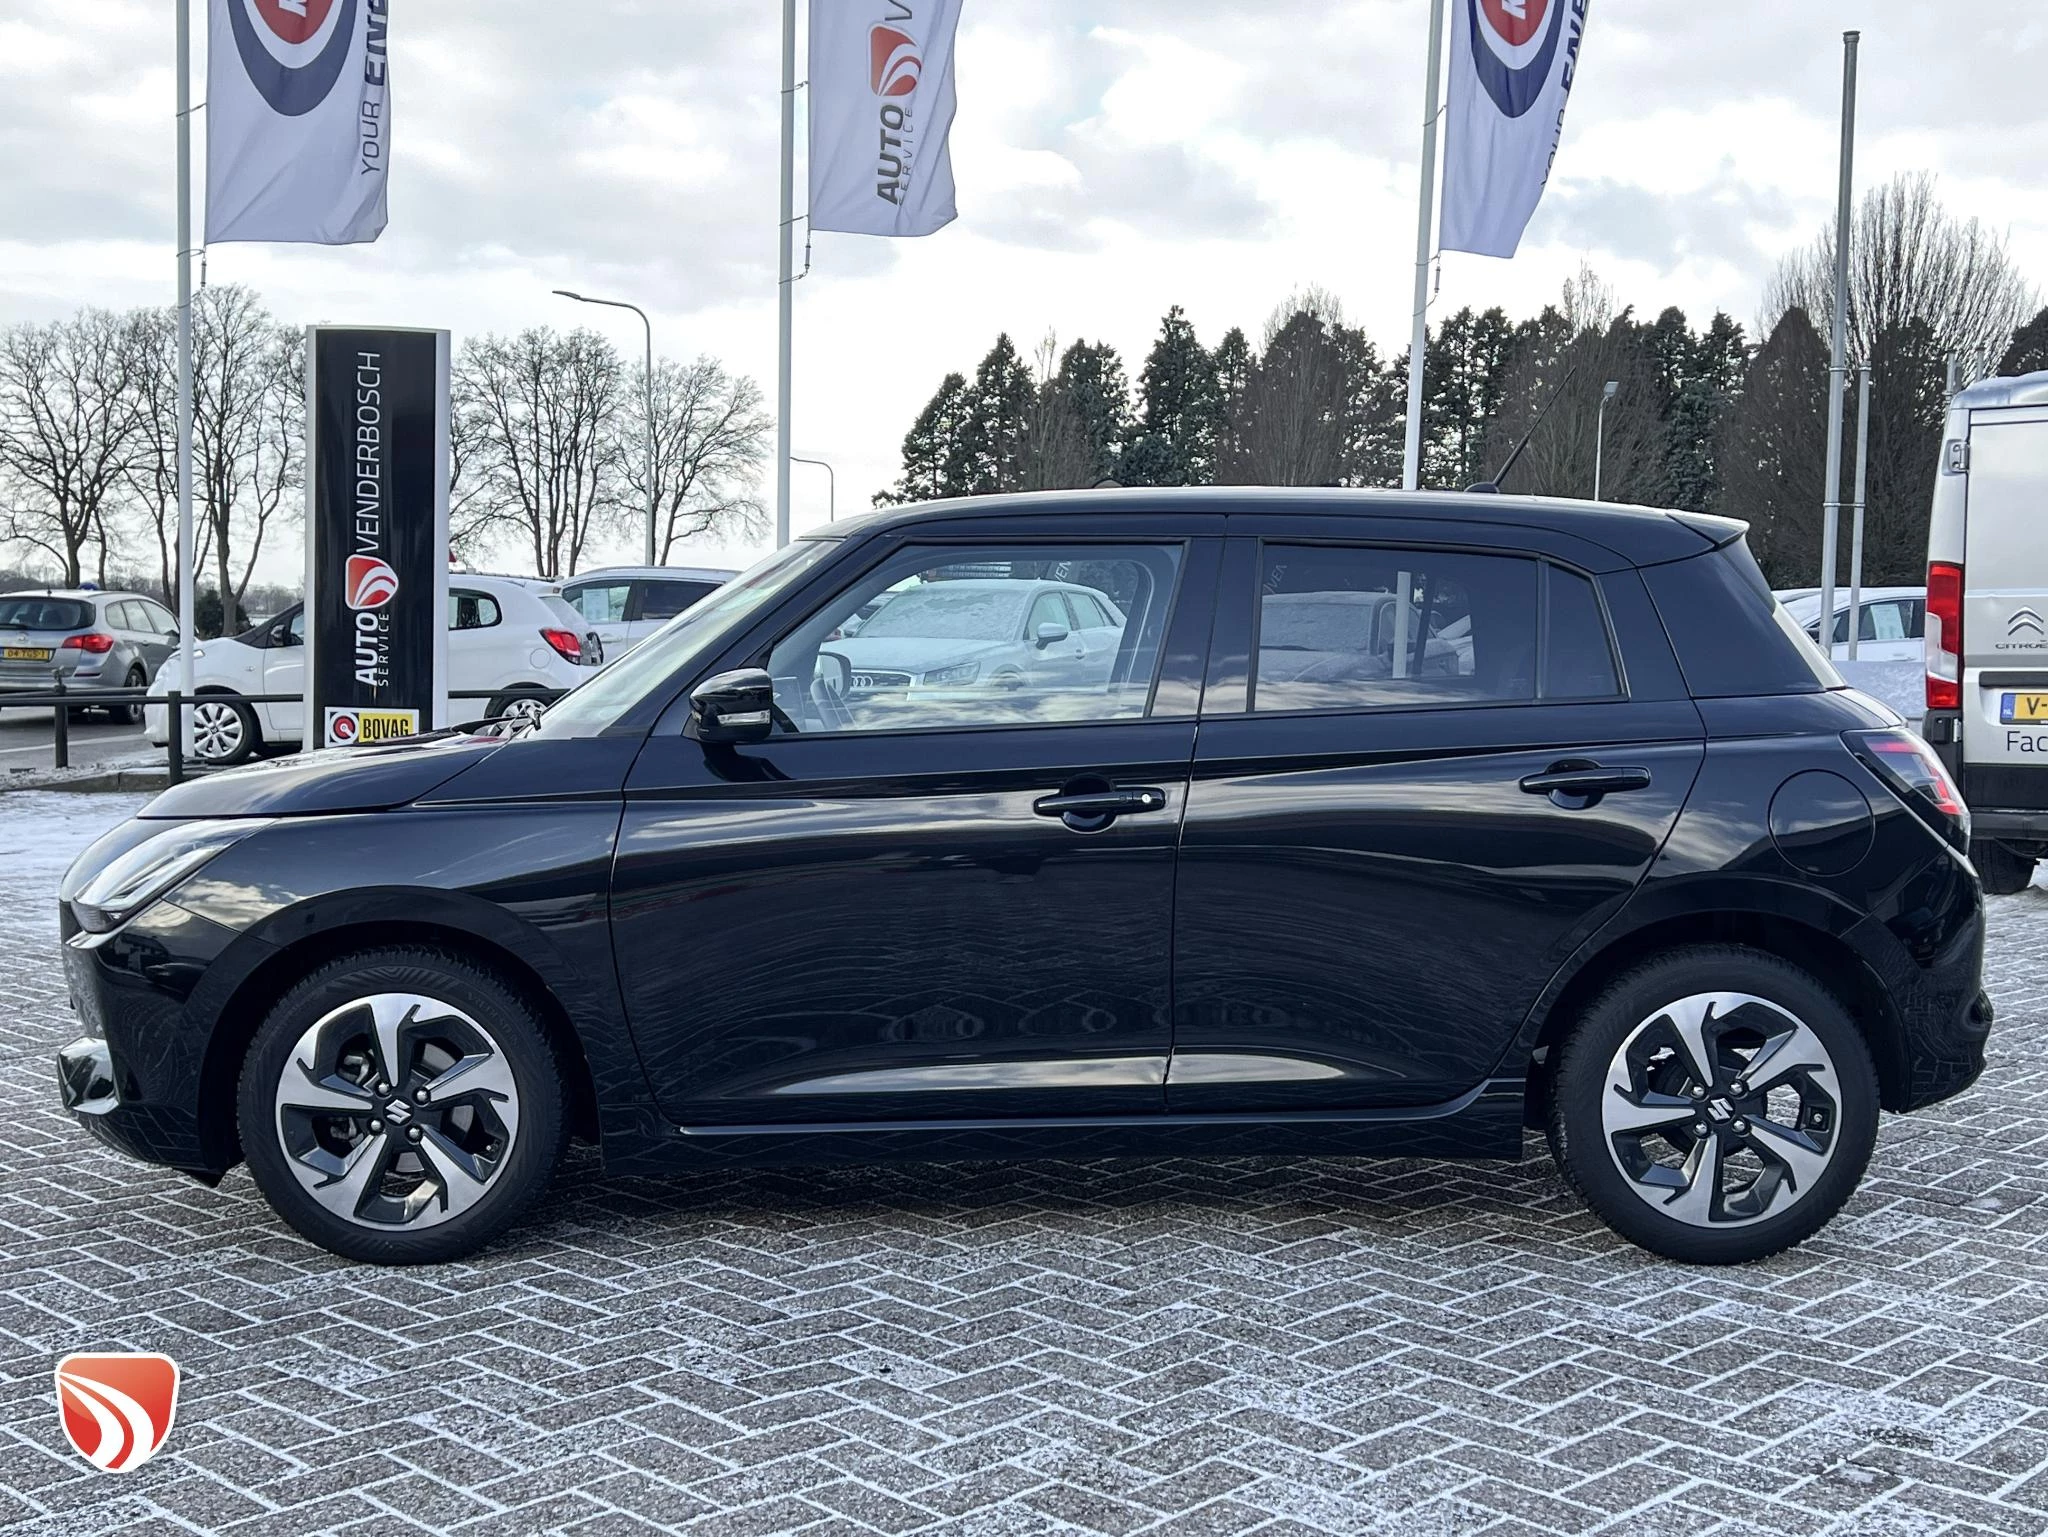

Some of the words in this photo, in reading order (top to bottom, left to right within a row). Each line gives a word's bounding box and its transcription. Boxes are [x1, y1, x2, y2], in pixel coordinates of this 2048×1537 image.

[361, 101, 380, 175] YOUR
[877, 104, 904, 206] AUTO
[355, 352, 381, 553] VENDERBOSCH
[355, 612, 379, 687] AUTO
[377, 613, 390, 687] SERVICE
[363, 718, 409, 740] BOVAG
